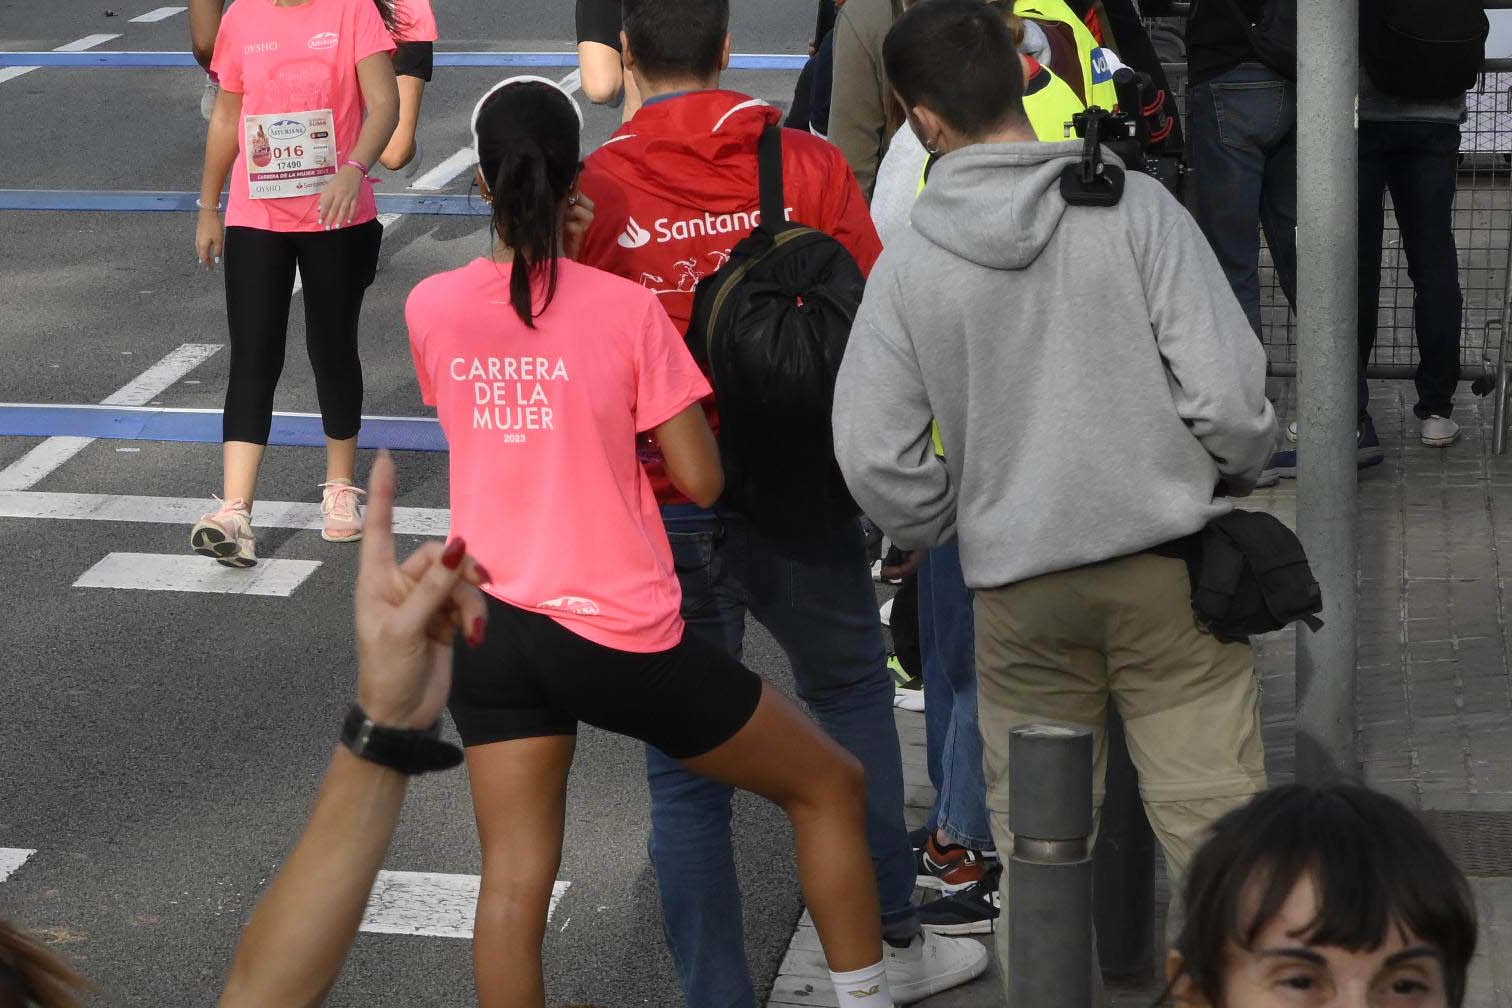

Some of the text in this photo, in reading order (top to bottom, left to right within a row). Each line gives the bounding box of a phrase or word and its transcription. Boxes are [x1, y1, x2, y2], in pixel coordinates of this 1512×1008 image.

[273, 145, 304, 159] 016
[277, 161, 302, 170] 17490
[450, 356, 569, 381] CARRERA
[474, 381, 548, 405] DE LA
[472, 407, 554, 431] MUJER
[503, 434, 526, 443] 2023
